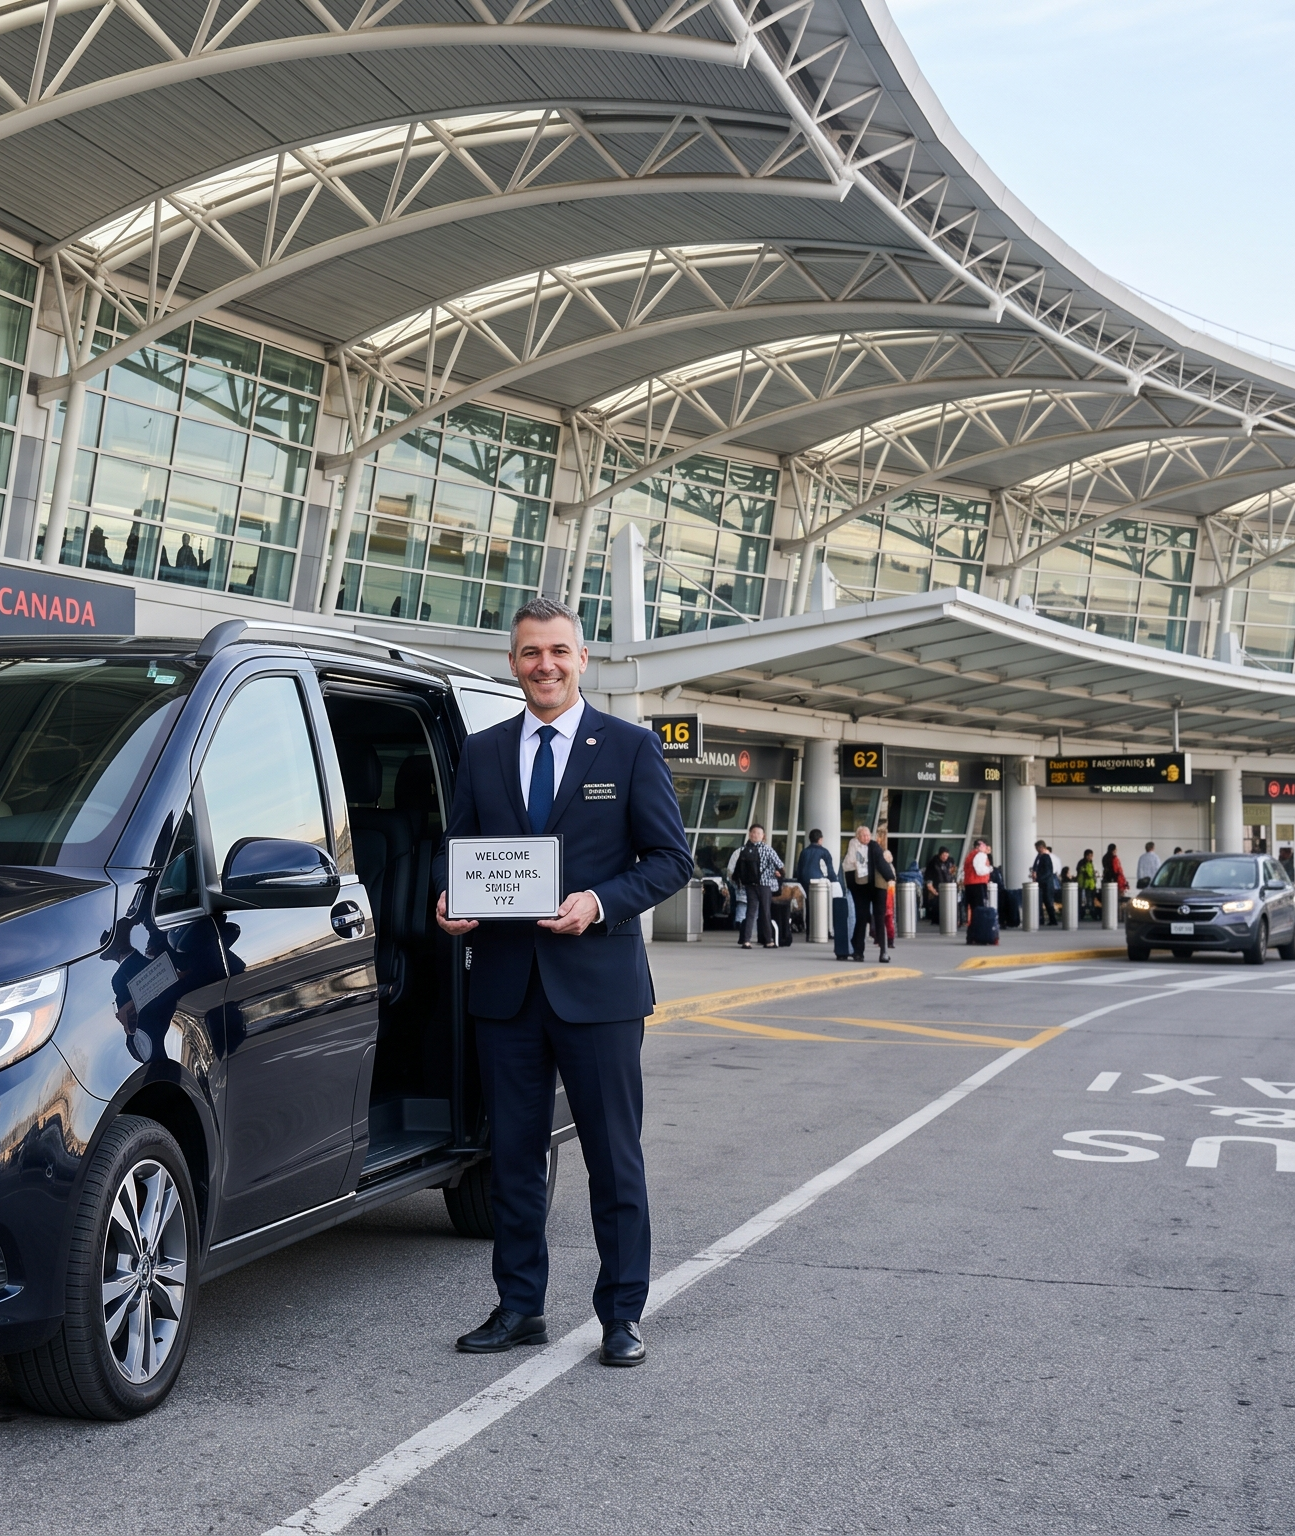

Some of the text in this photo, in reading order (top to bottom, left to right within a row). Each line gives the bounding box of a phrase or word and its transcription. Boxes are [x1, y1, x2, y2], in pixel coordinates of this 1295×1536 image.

[661, 722, 690, 742] 16
[853, 751, 878, 768] 62
[475, 850, 530, 861] WELCOME
[466, 869, 541, 880] MR. AND MRS.
[493, 896, 514, 905] YYZ
